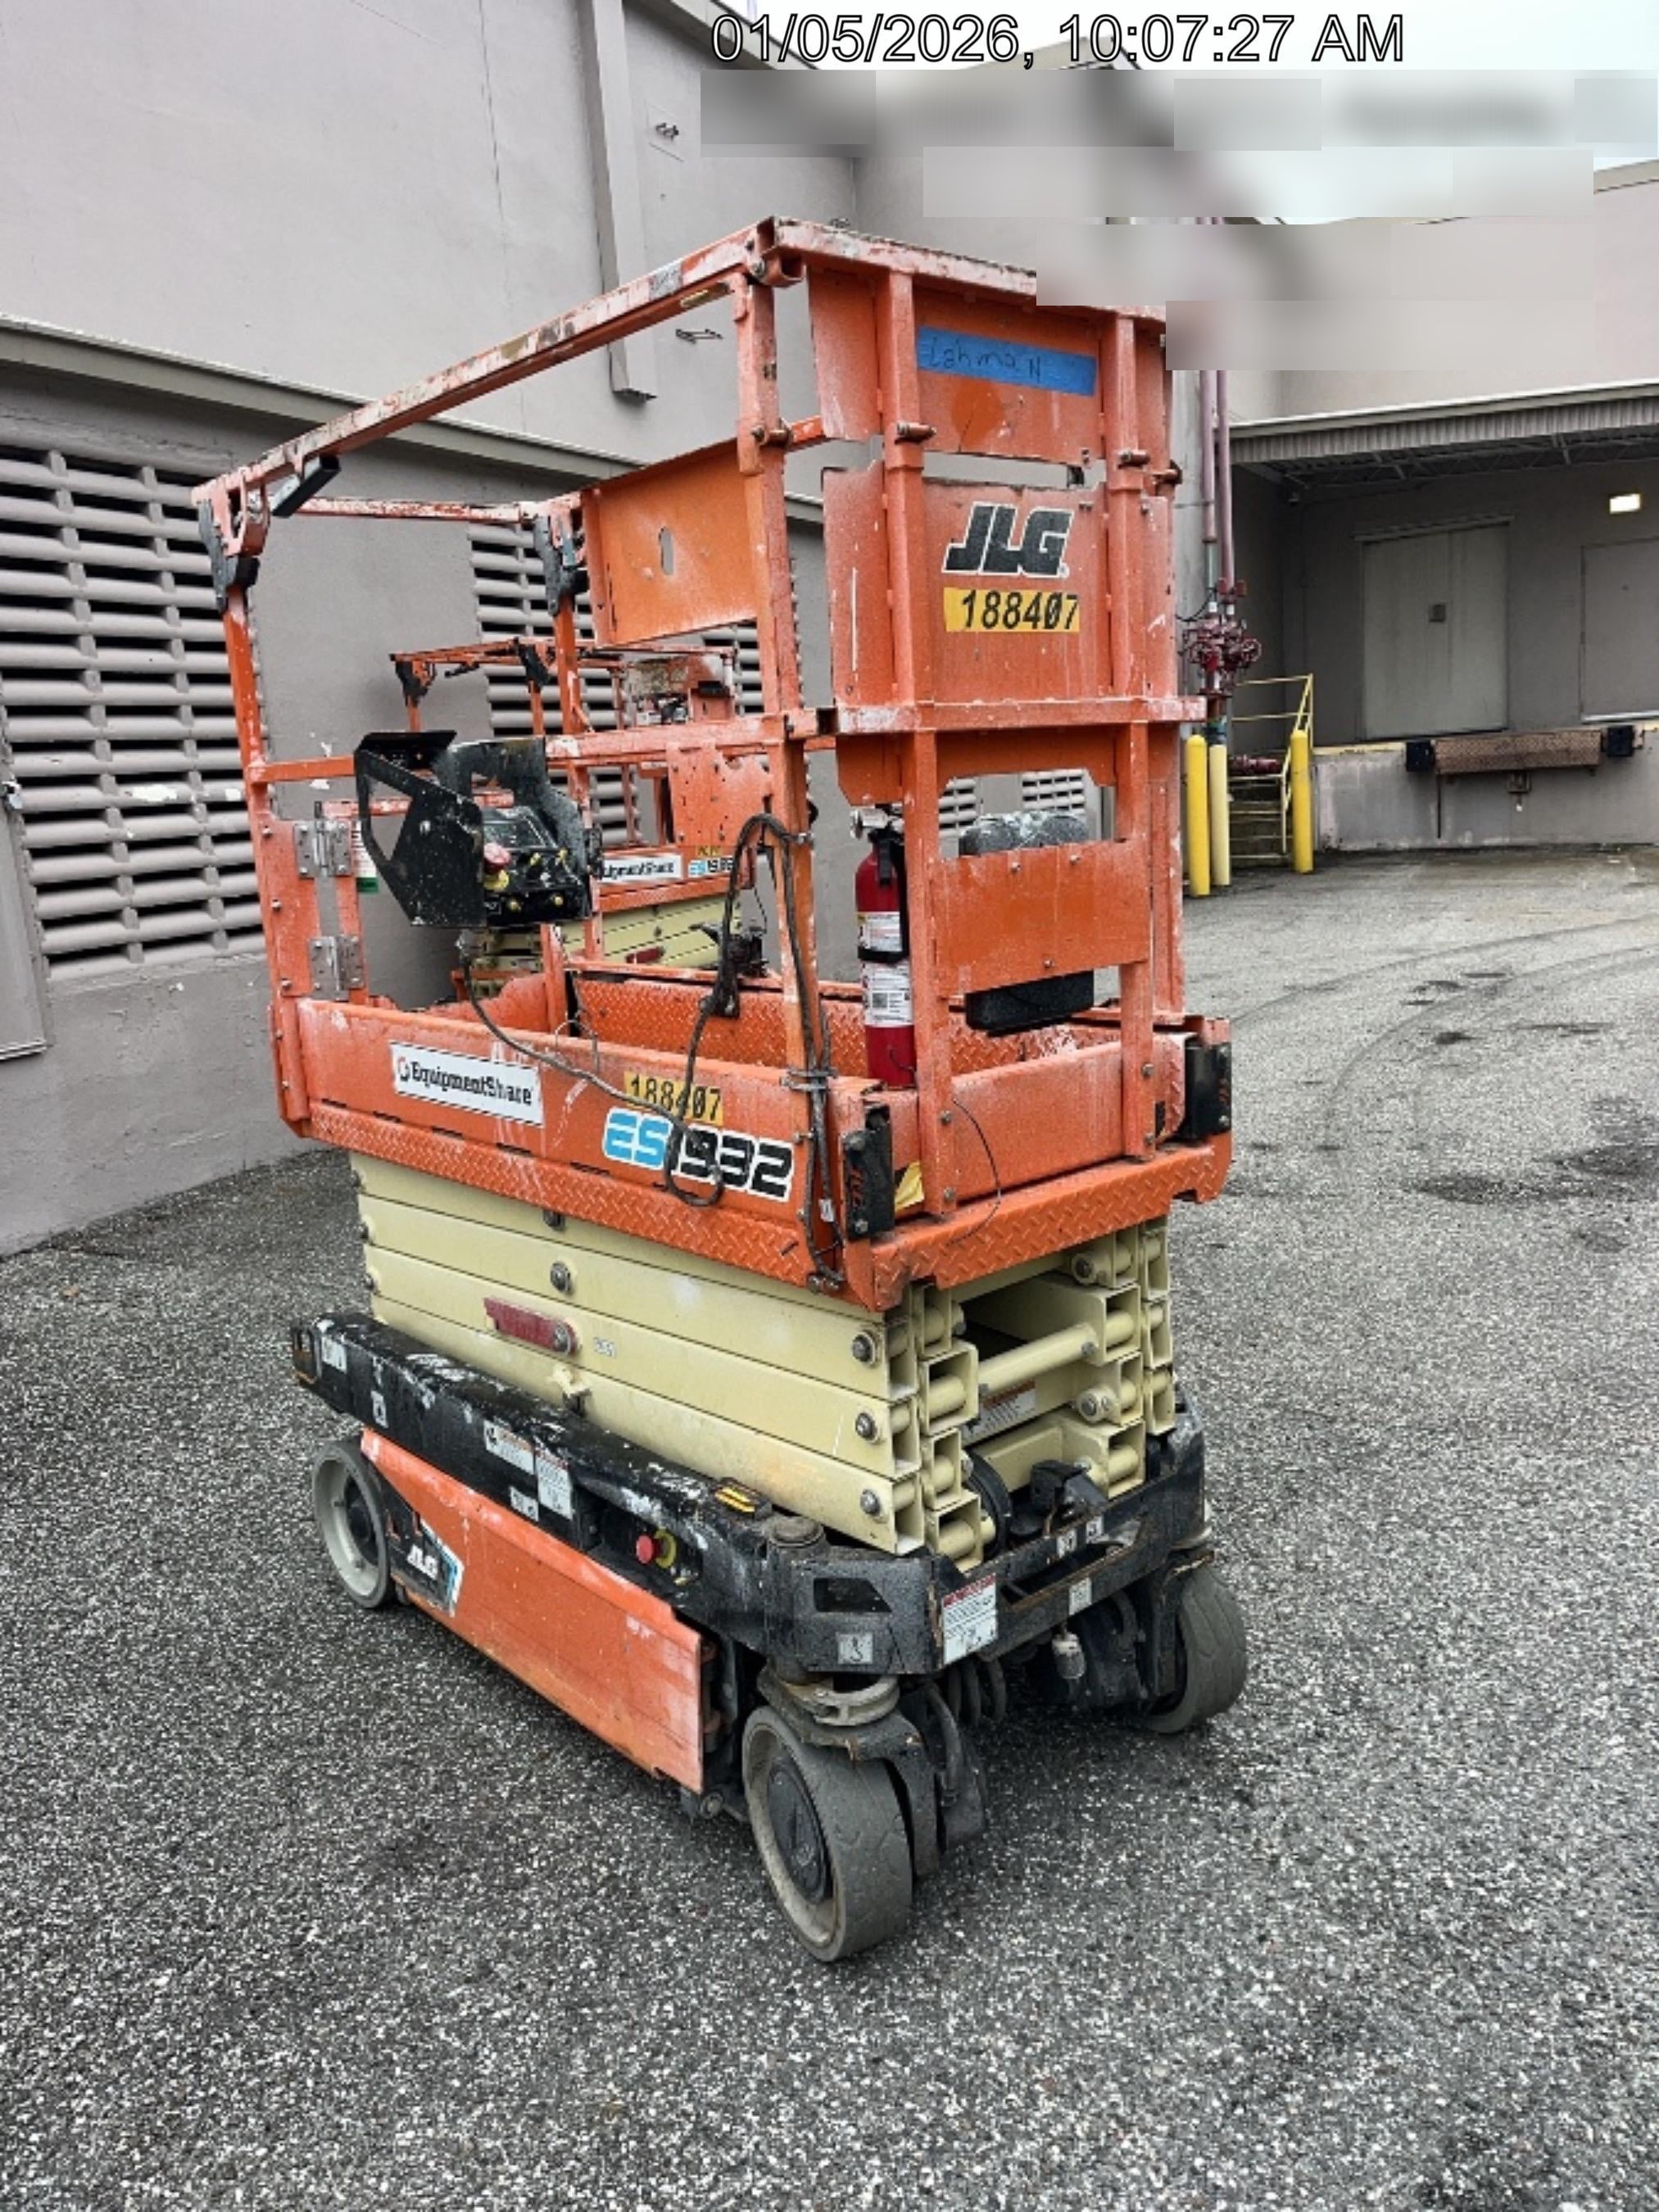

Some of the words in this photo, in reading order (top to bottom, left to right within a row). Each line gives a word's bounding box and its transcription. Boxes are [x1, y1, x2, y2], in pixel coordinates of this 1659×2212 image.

[943, 502, 1073, 577] JLG
[963, 590, 1078, 628] 188407
[411, 1061, 533, 1106] EquipmentShare
[603, 1108, 793, 1200] ES932
